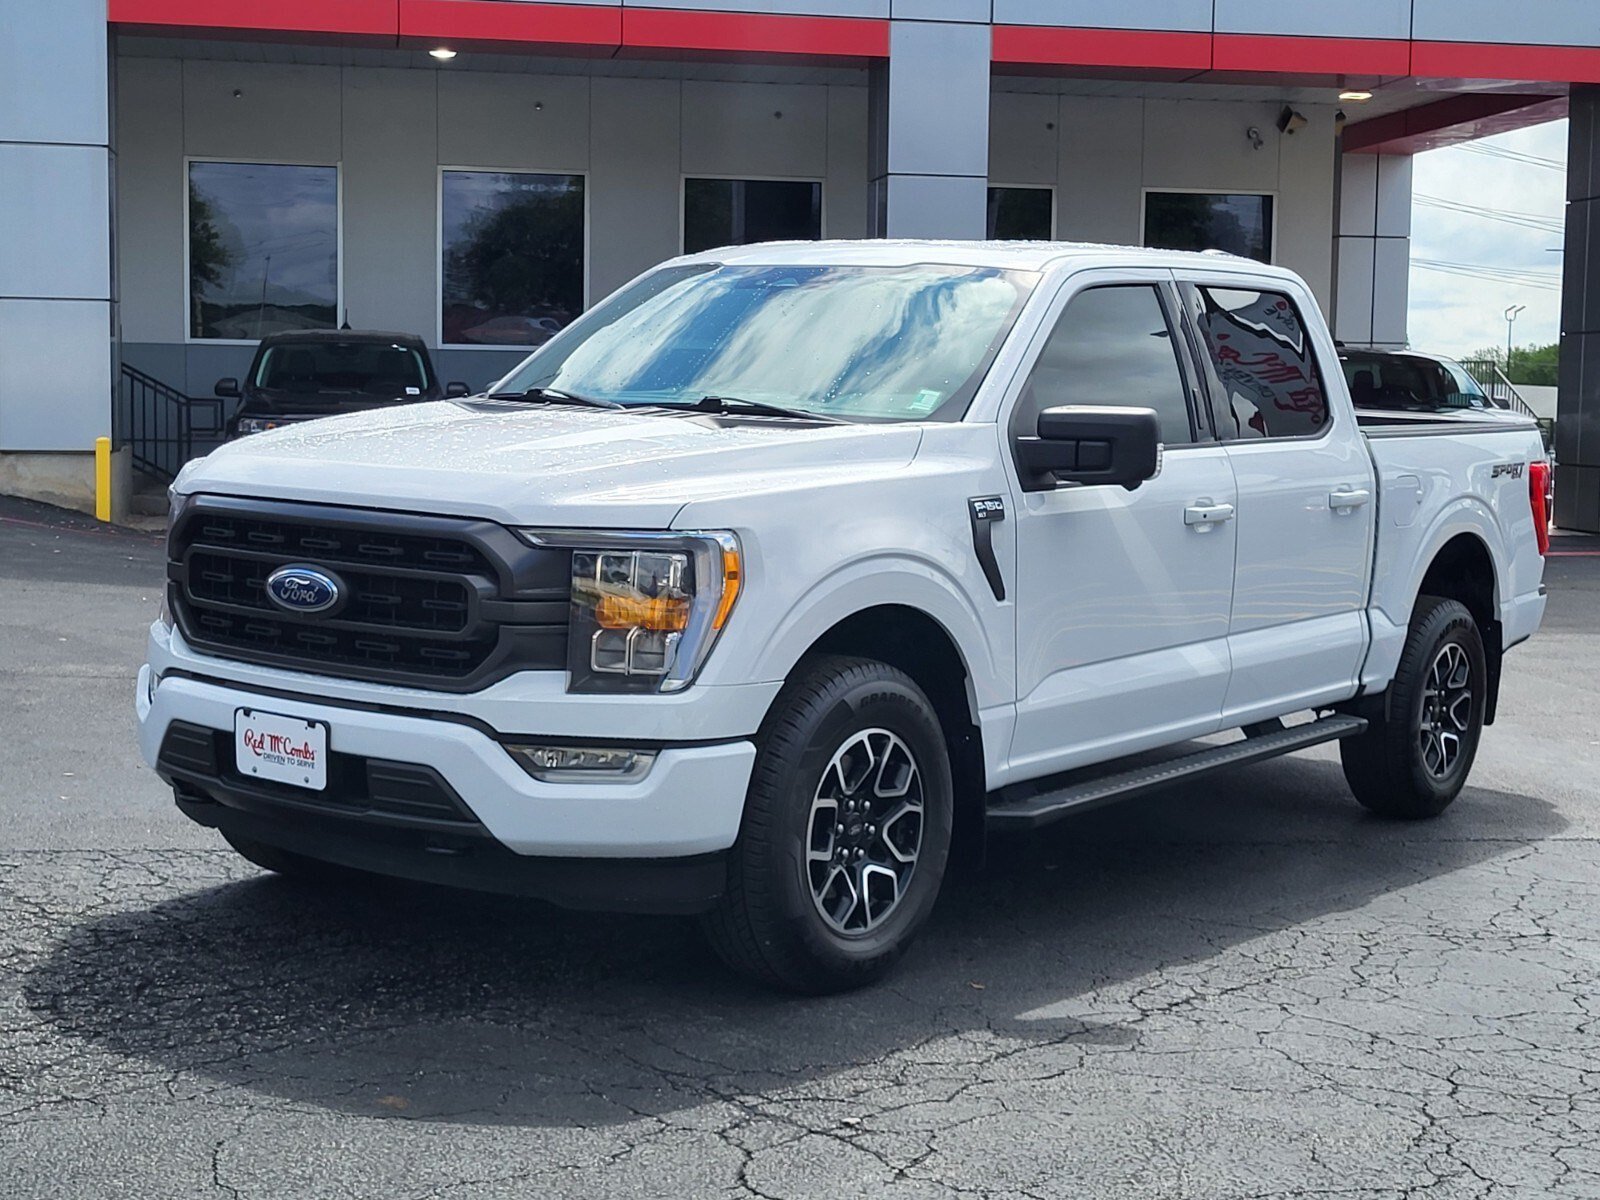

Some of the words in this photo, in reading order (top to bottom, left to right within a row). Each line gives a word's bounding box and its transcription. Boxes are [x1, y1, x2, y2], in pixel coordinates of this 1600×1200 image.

[1491, 462, 1525, 478] SPORT
[974, 501, 1004, 511] F-150
[281, 577, 319, 603] Ford
[244, 728, 265, 756] Red
[263, 752, 285, 763] DRIVEN
[287, 757, 296, 765] TO
[296, 759, 315, 770] SERVE
